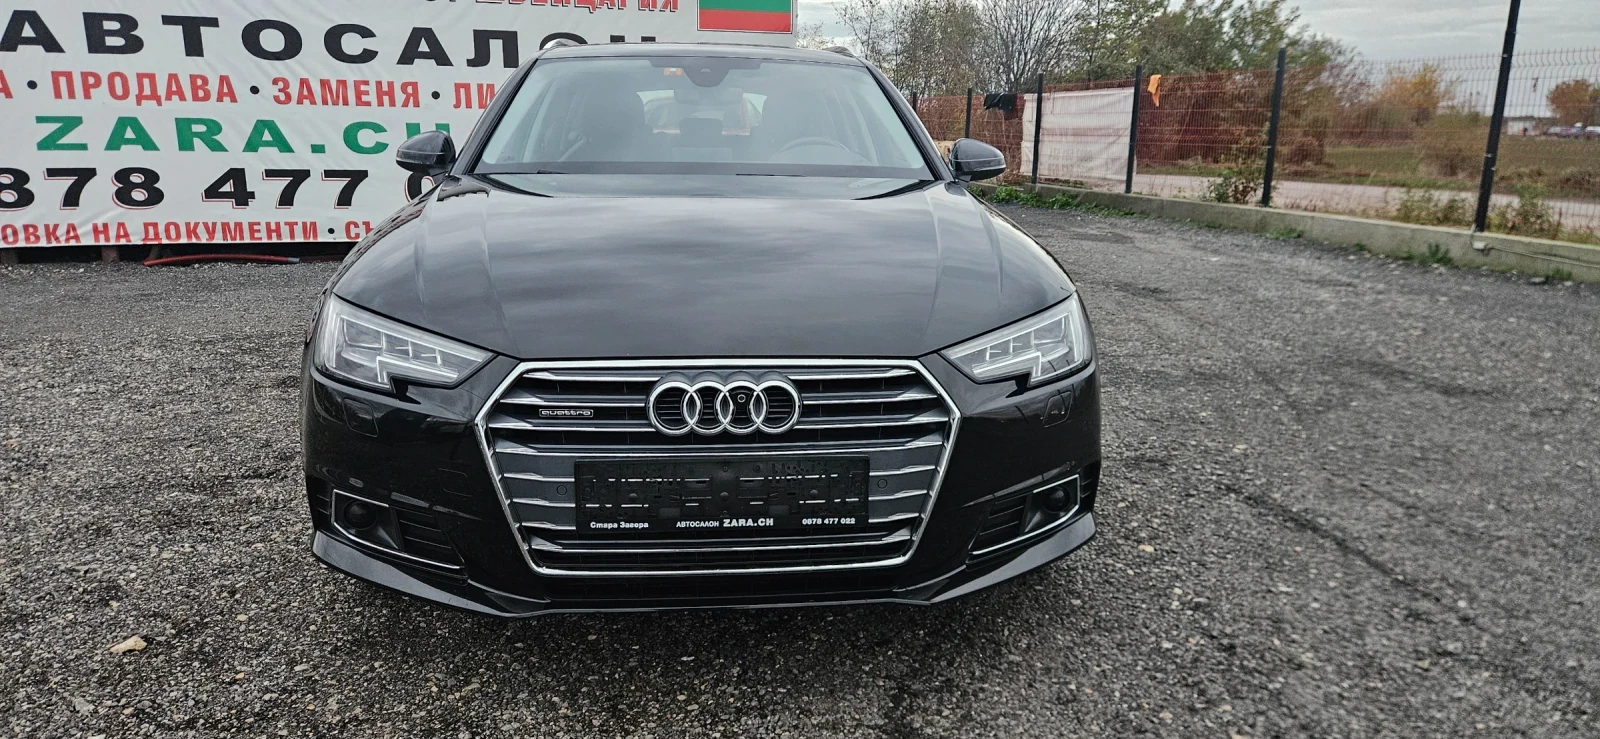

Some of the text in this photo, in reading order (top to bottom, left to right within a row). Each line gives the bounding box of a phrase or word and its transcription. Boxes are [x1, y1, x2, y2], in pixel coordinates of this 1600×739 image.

[0, 9, 656, 69] АВТОСАЛ
[51, 71, 238, 106] ПРОДАВА
[272, 77, 420, 108] ЗАМЕНЯ
[201, 167, 369, 211] 477
[1, 223, 81, 246] ОВКА
[92, 222, 131, 244] НА
[142, 220, 318, 245] ДОКУМЕНТИ
[590, 521, 618, 529] Стара
[619, 521, 649, 529] Загора
[676, 520, 719, 528] АВТОСАЛОН
[723, 518, 774, 527] ZARA.CH
